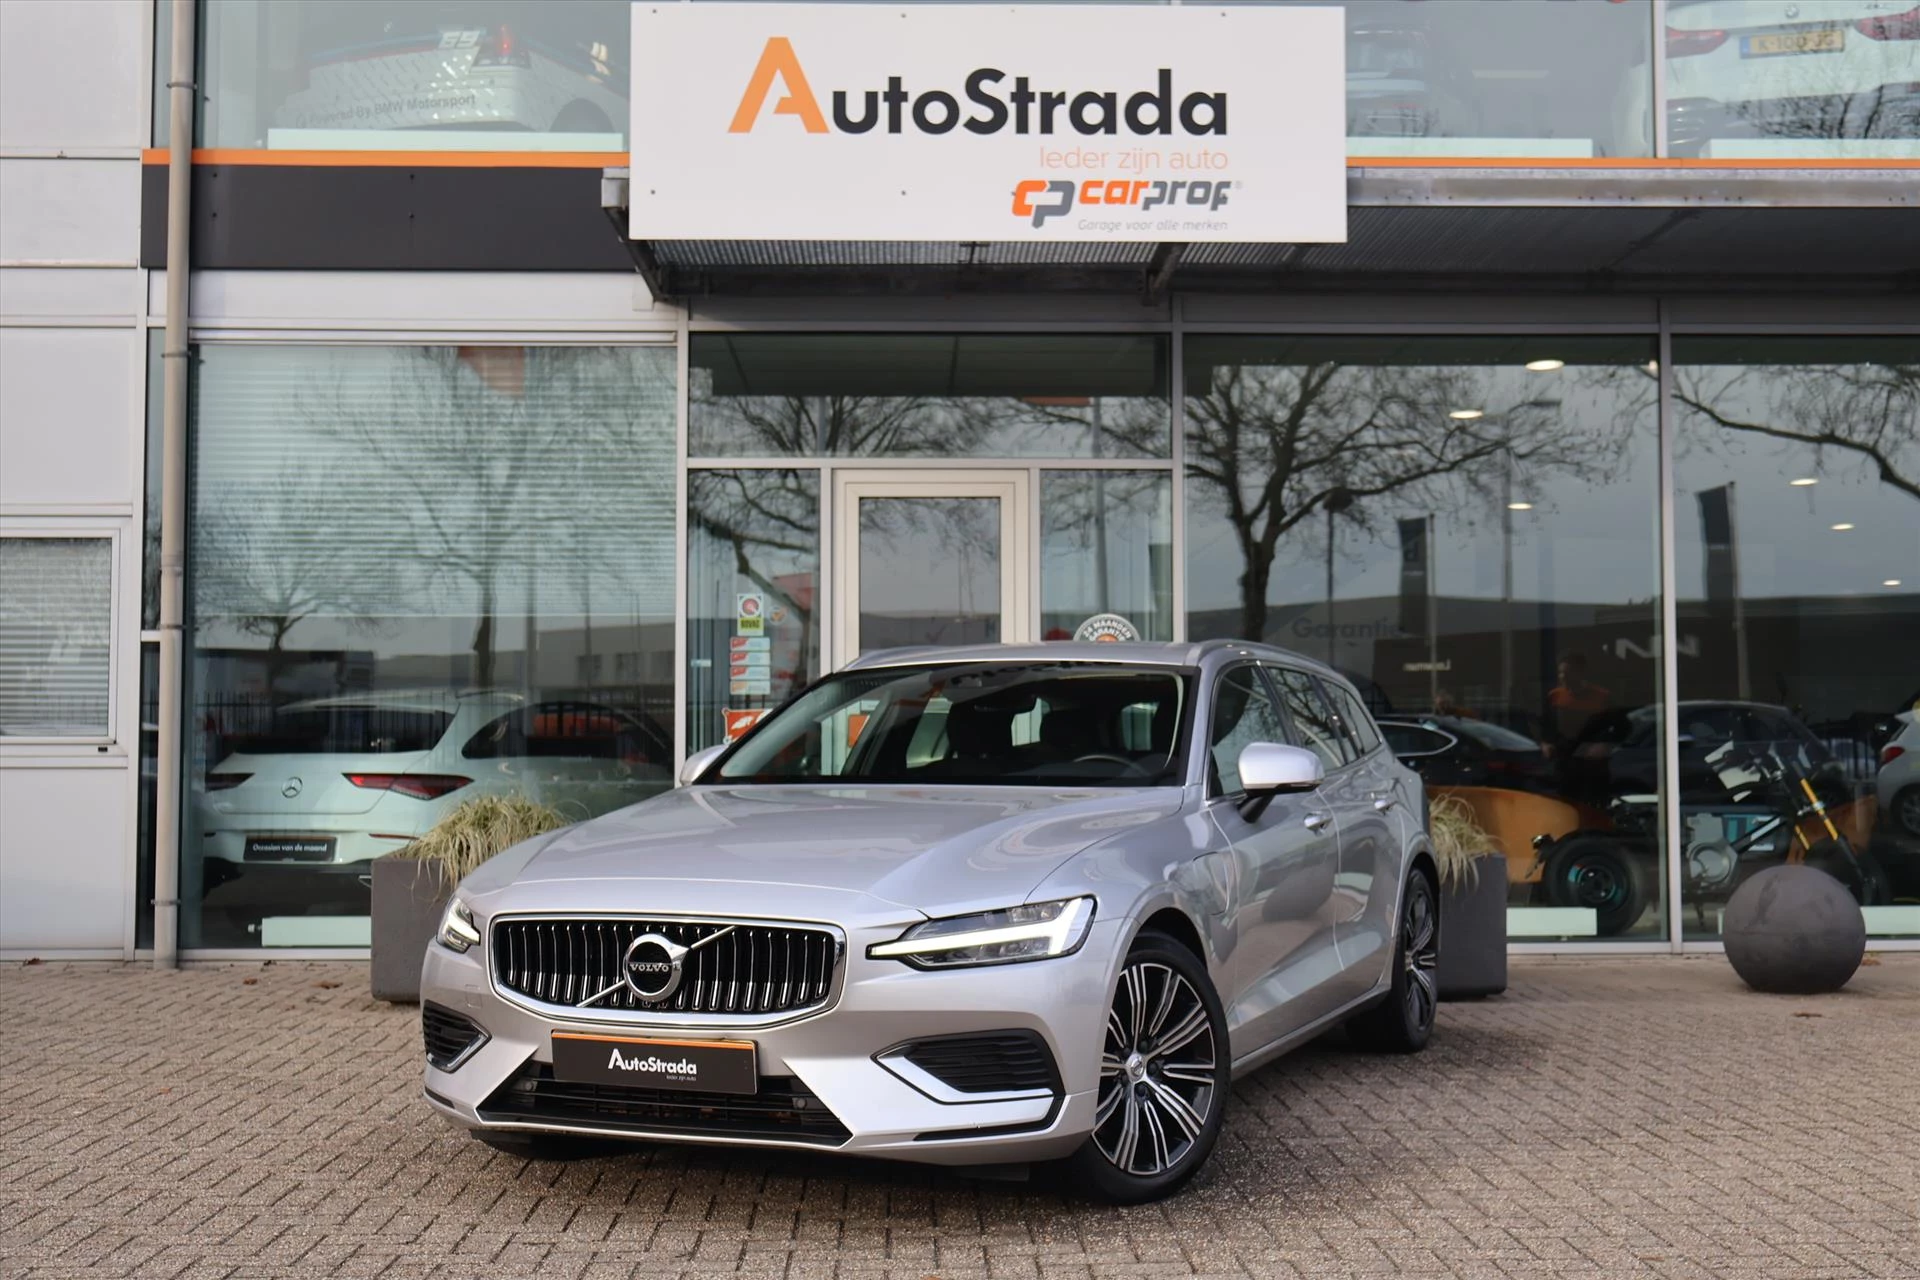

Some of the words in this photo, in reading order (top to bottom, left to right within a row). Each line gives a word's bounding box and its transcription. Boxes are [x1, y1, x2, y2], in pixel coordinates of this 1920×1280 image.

[727, 36, 1228, 136] AutoStrada
[374, 98, 403, 115] BMW
[406, 94, 476, 111] Motorsport
[1039, 146, 1109, 169] Ieder
[1118, 147, 1161, 174] zijn
[1169, 150, 1229, 170] auto
[1078, 219, 1122, 232] Garage
[1126, 221, 1151, 231] voor
[1156, 219, 1179, 231] alle
[1182, 219, 1228, 231] merken
[629, 963, 670, 973] VOLVO
[608, 1048, 697, 1075] AutoStrada
